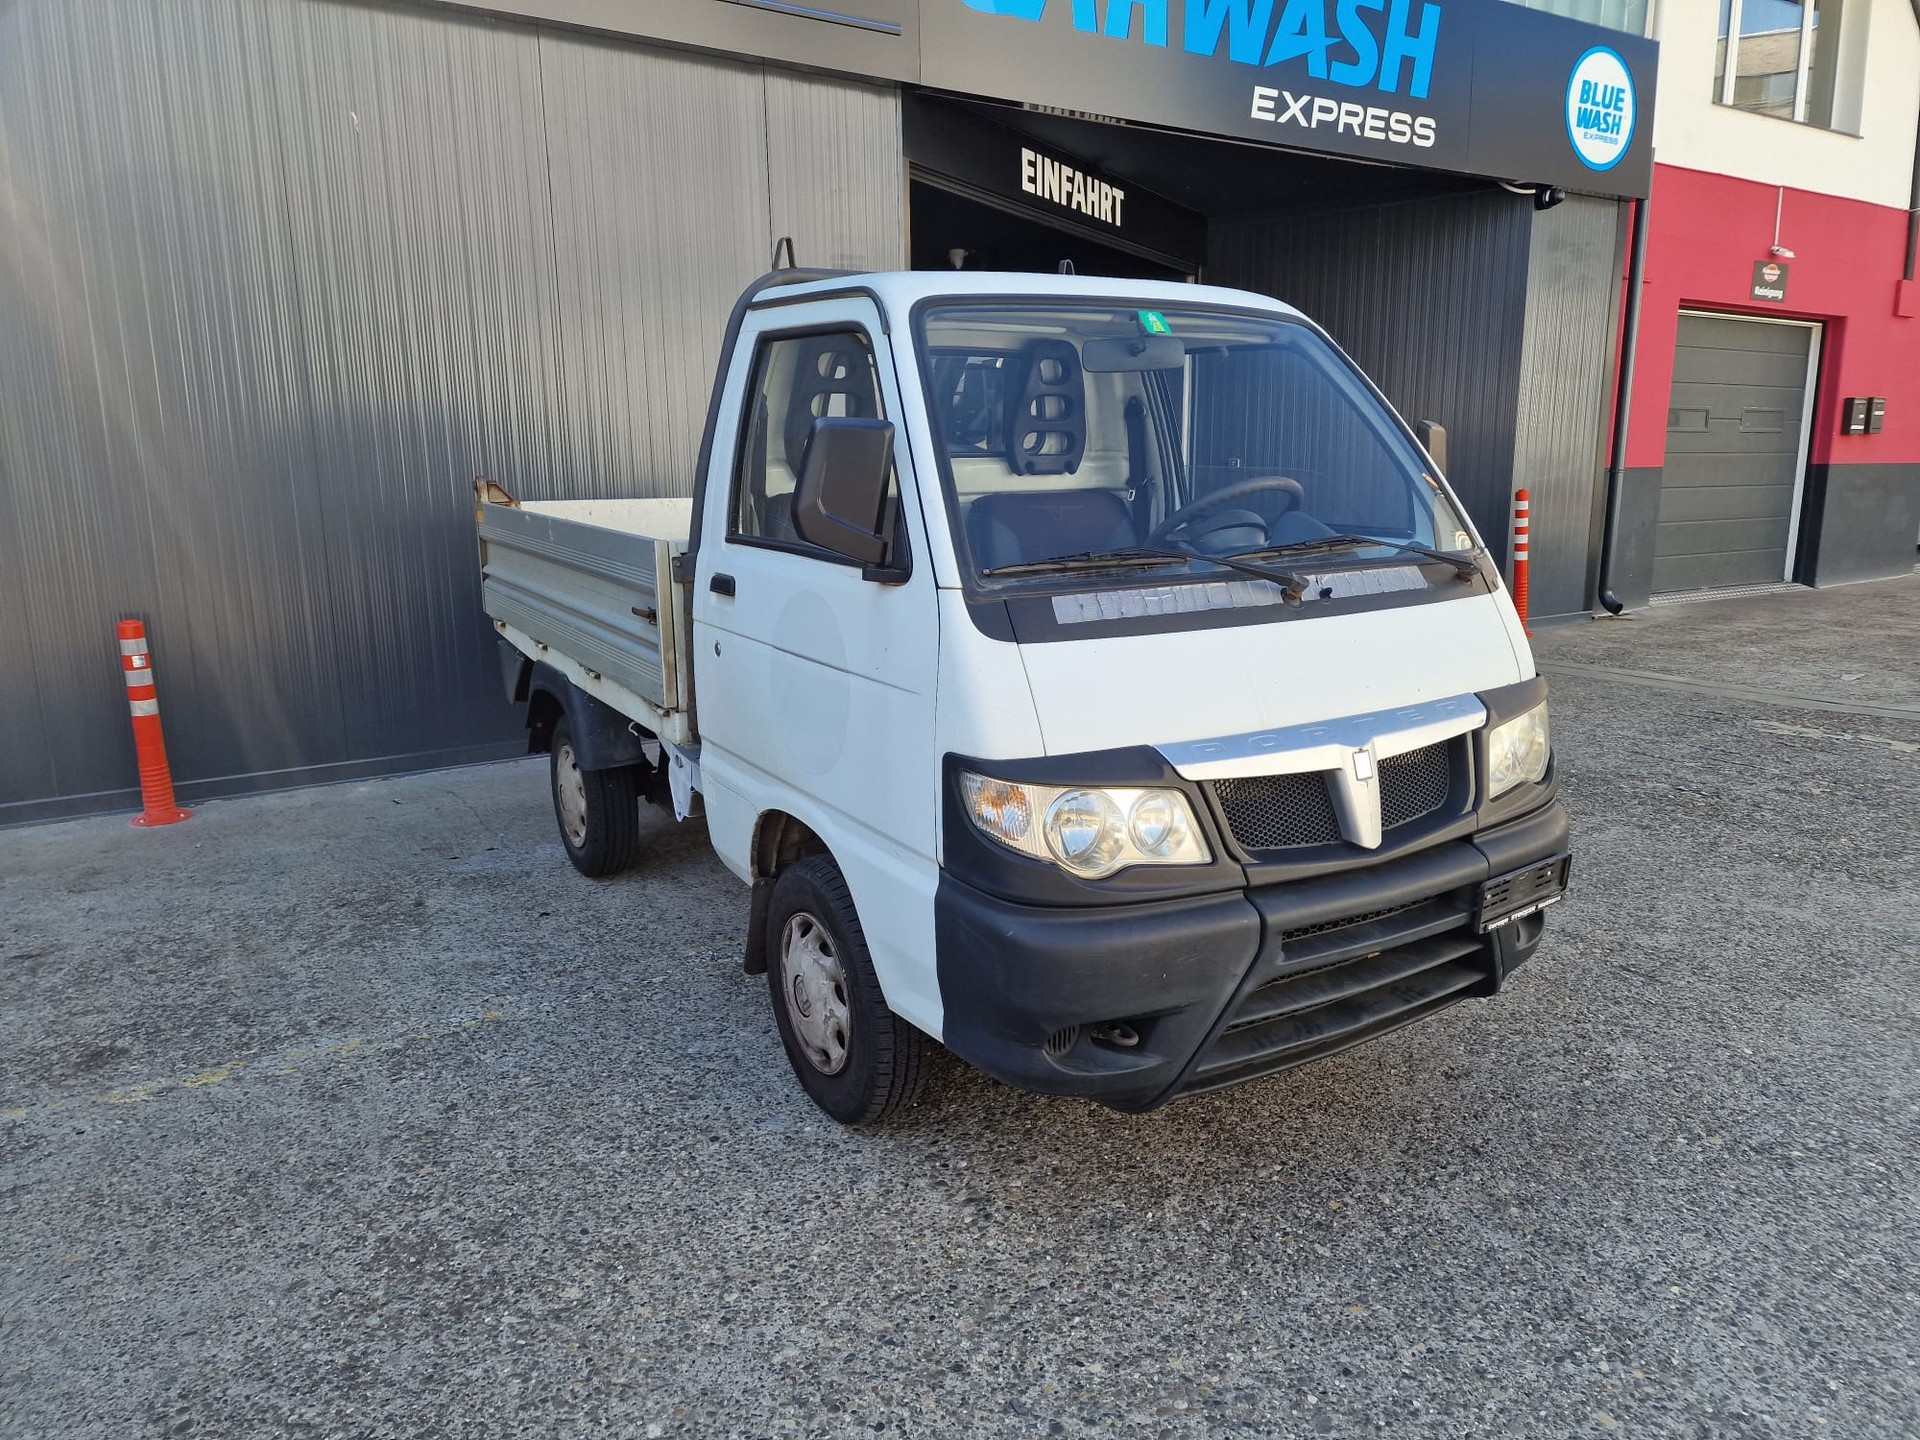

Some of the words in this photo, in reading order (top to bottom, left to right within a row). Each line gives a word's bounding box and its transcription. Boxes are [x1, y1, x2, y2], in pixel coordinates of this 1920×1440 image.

[1579, 79, 1625, 112] BLUE
[1251, 85, 1436, 147] EXPRESS
[1576, 106, 1622, 135] WASH
[1583, 131, 1618, 145] EXPRESS
[1021, 147, 1125, 227] EINFAHRT
